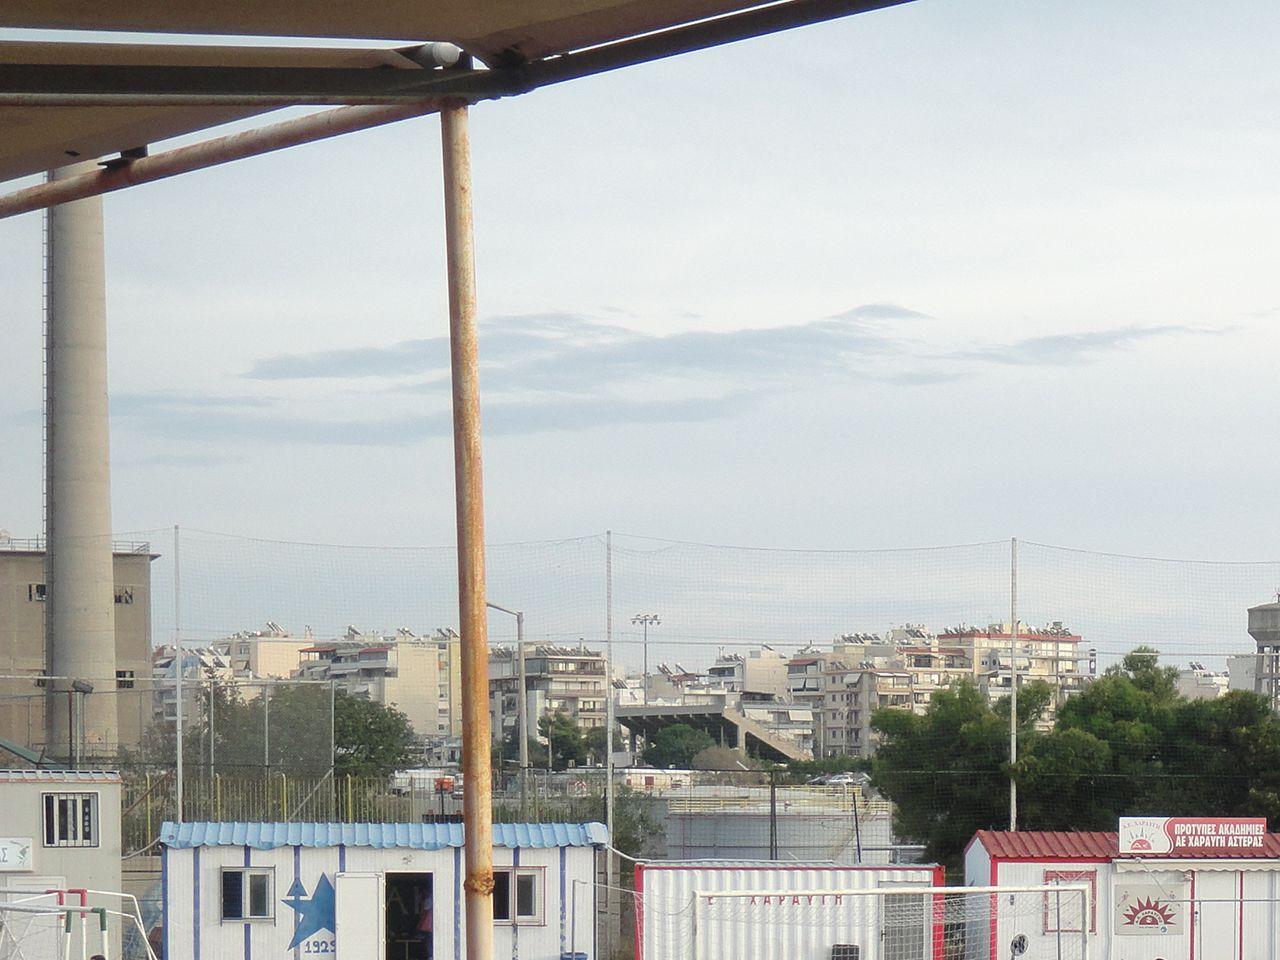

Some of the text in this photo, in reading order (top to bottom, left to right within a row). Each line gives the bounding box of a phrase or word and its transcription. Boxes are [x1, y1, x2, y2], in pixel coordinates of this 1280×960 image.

[1175, 823, 1264, 835] ΠΡΟΤΥΠΕΣ ΑΚΑΔΗΜΙΕΣ
[1176, 836, 1263, 847] ΑΕ ΧΑΡΑΥΓΗ ΑΣΤΕΡΑΣ
